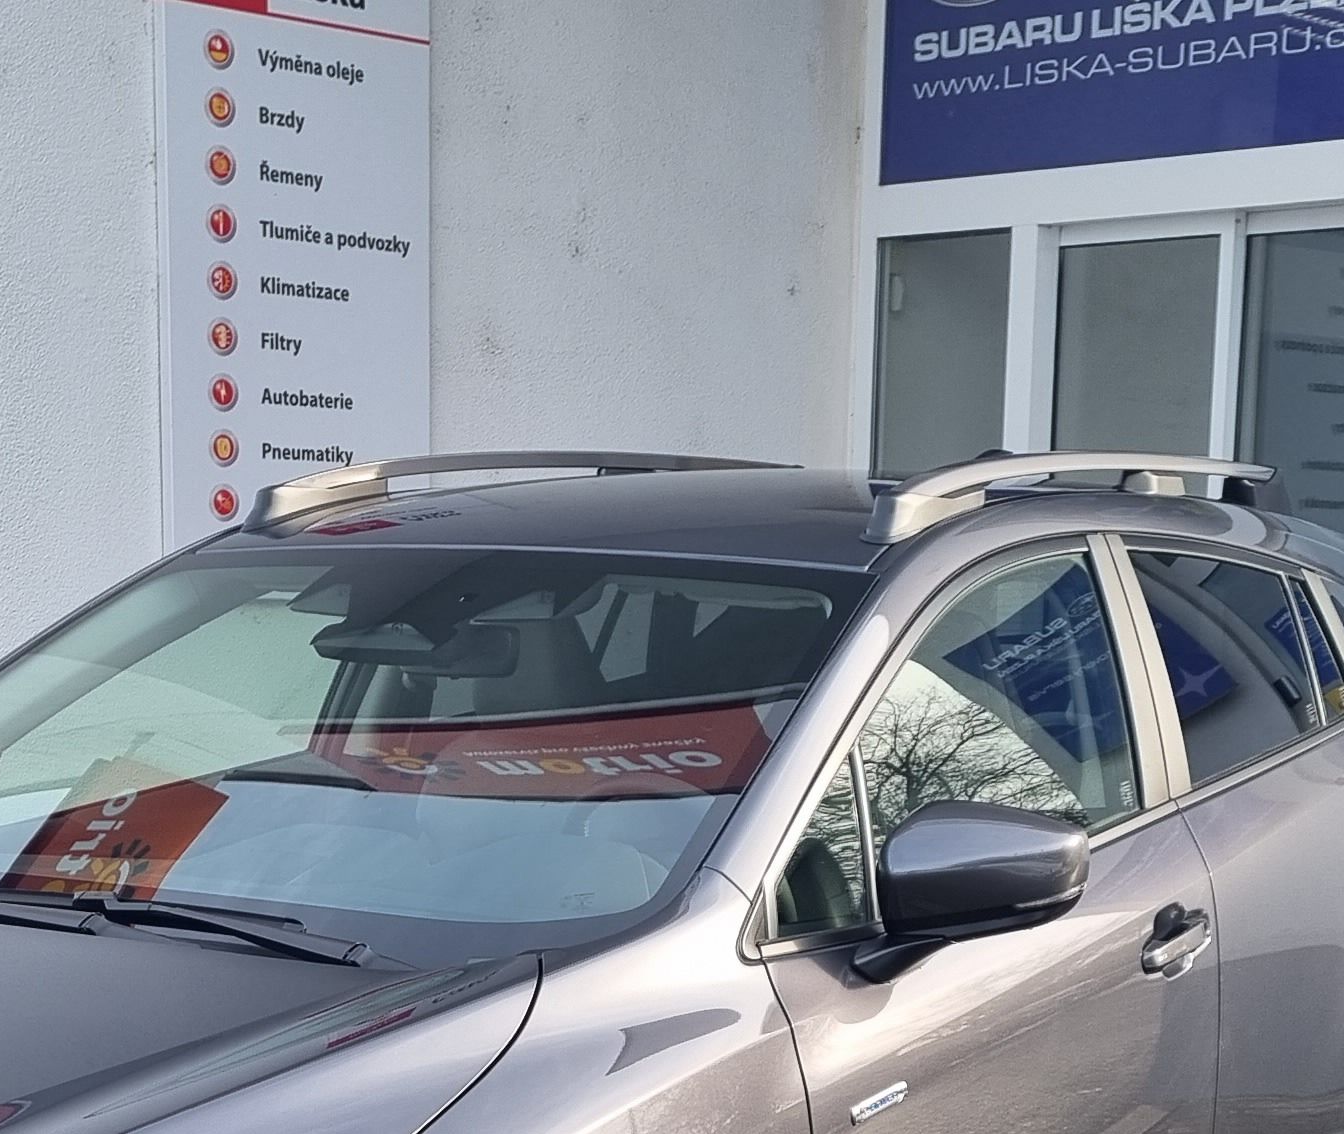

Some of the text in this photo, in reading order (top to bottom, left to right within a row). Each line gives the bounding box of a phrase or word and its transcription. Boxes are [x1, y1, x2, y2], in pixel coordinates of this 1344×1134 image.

[913, 9, 1087, 63] SUBARU
[258, 47, 364, 84] Výměna oleje
[259, 107, 305, 134] Brzdy
[259, 161, 323, 191] Řemeny
[259, 220, 411, 258] Tlumiče a podvozky
[260, 276, 350, 302] Klimatizace
[261, 332, 302, 356] Filtry
[262, 388, 353, 411] Autobaterie
[262, 442, 353, 466] Pneumatiky
